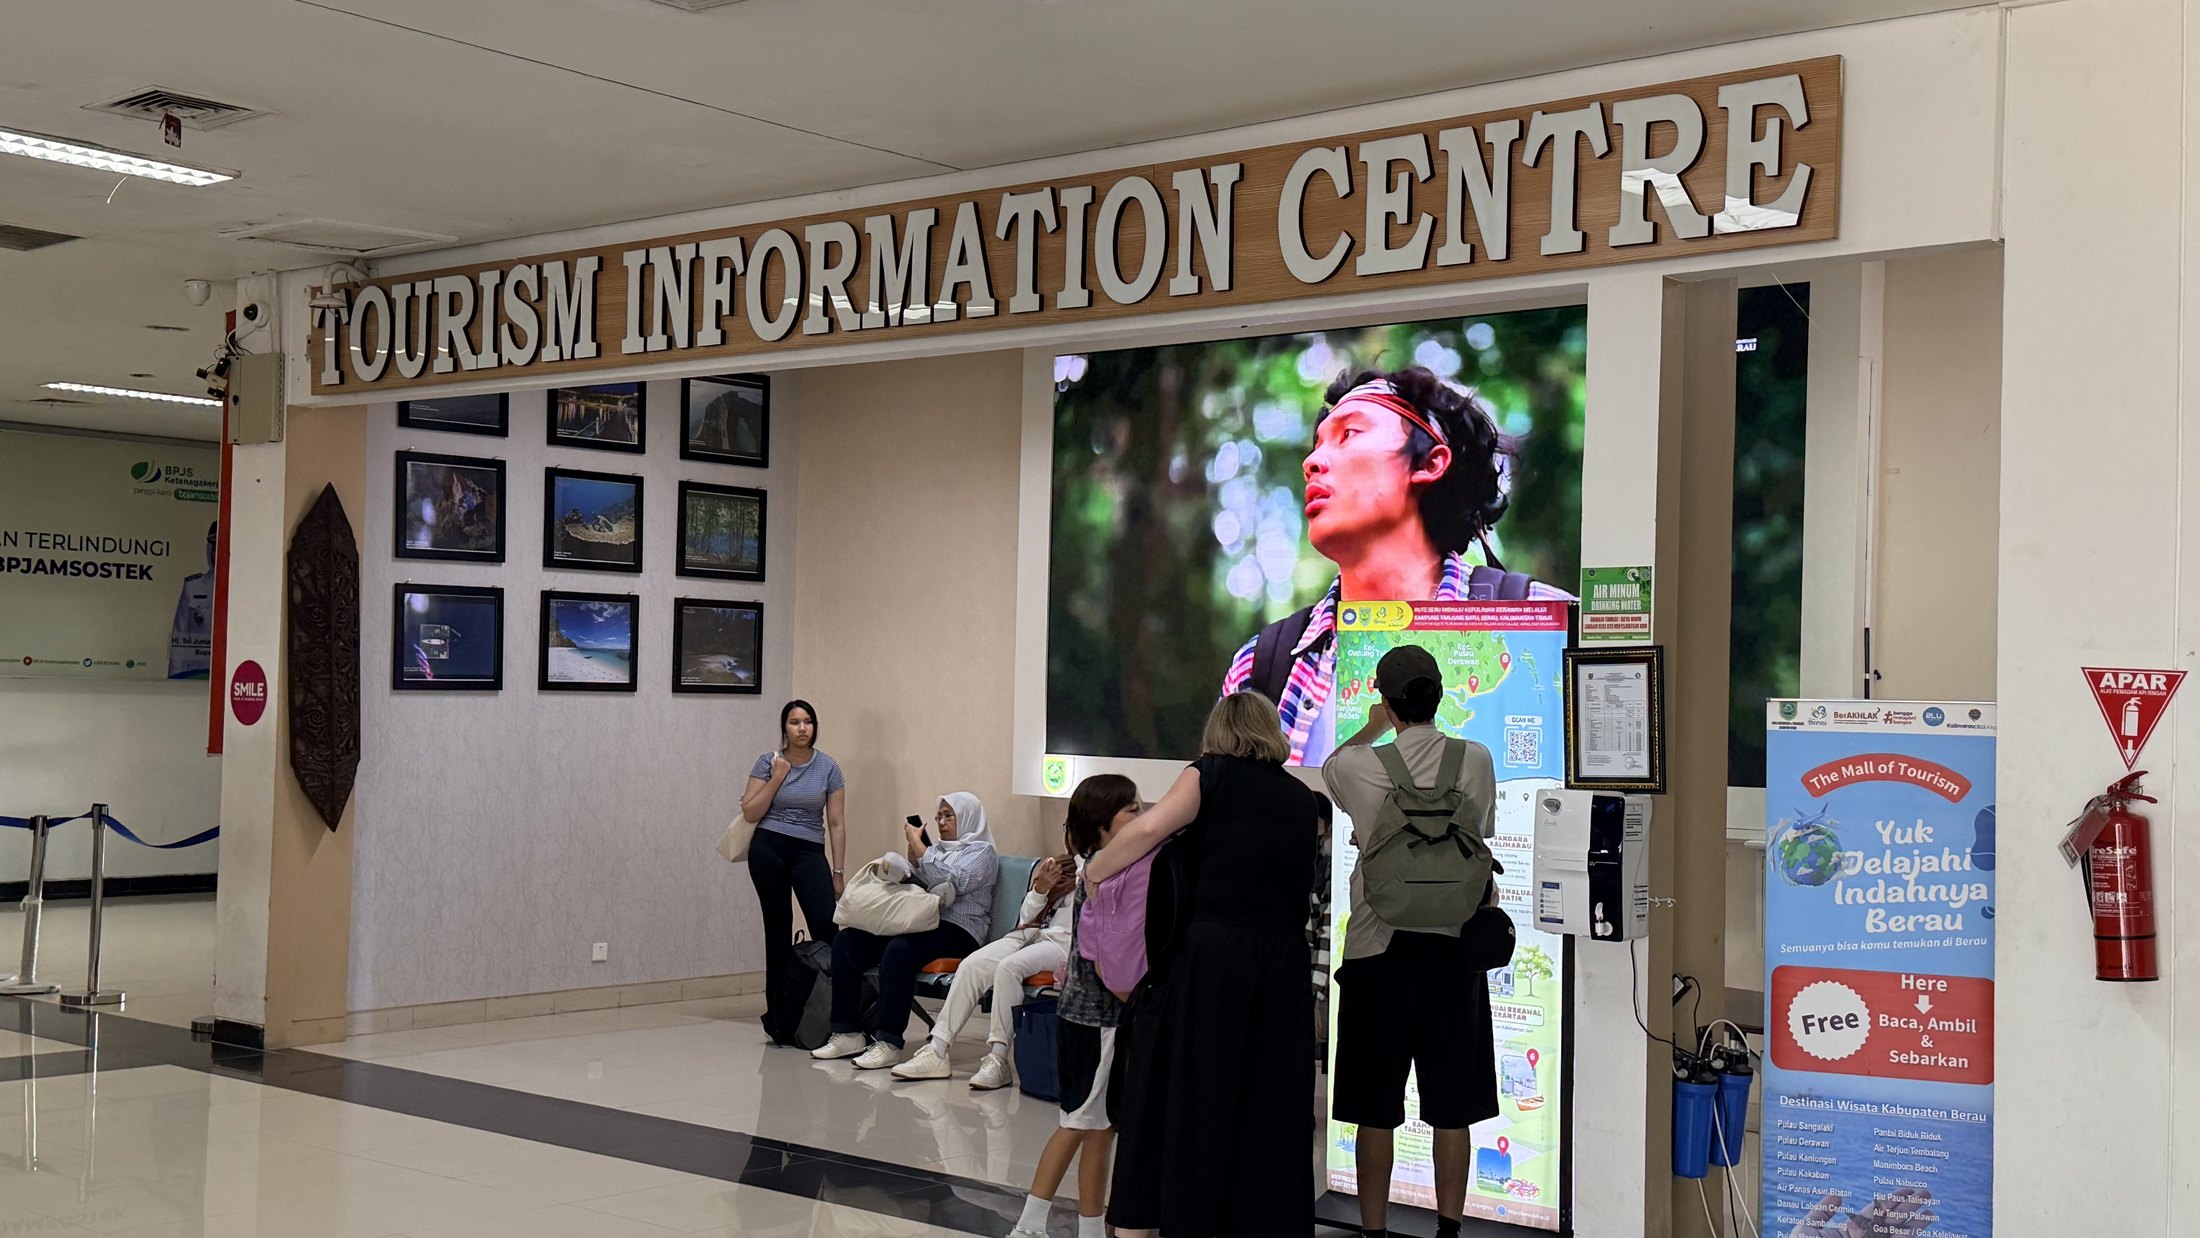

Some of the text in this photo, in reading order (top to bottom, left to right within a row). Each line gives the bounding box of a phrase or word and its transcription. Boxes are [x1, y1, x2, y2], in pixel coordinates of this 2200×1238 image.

[313, 74, 1811, 387] TOURISM INFORMATION CENTRE
[165, 466, 193, 477] BPJS
[0, 531, 170, 557] N TERLINDUNGI
[1593, 583, 1640, 599] AIR MINUM
[233, 682, 264, 697] SMILE
[2099, 673, 2167, 691] APAR
[1834, 710, 1879, 719] BerAKHLAK
[1809, 760, 1960, 796] The Mall of Tourism
[1874, 819, 1935, 845] Yuk
[1844, 847, 1972, 881] Jelajahi
[1834, 878, 1989, 909] Indahnya
[1865, 908, 1964, 934] Berau
[1780, 936, 1988, 955] Semuanya bisa kamu temukan di Berau
[1901, 973, 1948, 992] Here
[1801, 1012, 1860, 1036] Free
[1879, 1014, 1977, 1034] Baca, Ambil
[1920, 1035, 1934, 1048] &
[1889, 1050, 1969, 1068] Sebarkan
[1780, 1095, 1987, 1122] Destinasi Wisata Kabupaten Berau
[1777, 1120, 1834, 1133] Pulau Sangalaki
[1777, 1136, 1830, 1148] Pulau Derawan
[1873, 1128, 1942, 1141] Pantai Biduk Biduk
[1777, 1151, 1797, 1160] Pulau
[1873, 1144, 1885, 1152] Air
[1886, 1144, 1909, 1156] Terjun
[1777, 1167, 1830, 1180] Pulau Kakaban
[1915, 1163, 1938, 1173] Beach
[1777, 1184, 1788, 1192] Air
[1789, 1184, 1811, 1194] Panas
[1812, 1186, 1828, 1195] Asin
[1873, 1176, 1928, 1188] Pulau Nabucco
[1777, 1199, 1855, 1214] Danau Labuan Cermin
[1873, 1191, 1941, 1207] Hiu Paus Talisayan
[1777, 1215, 1805, 1226] Keraton
[1873, 1208, 1940, 1222] Air Terjun Palawan
[1872, 1224, 1888, 1233] Goa
[1889, 1225, 1911, 1235] Besar
[1916, 1228, 1931, 1237] Goa
